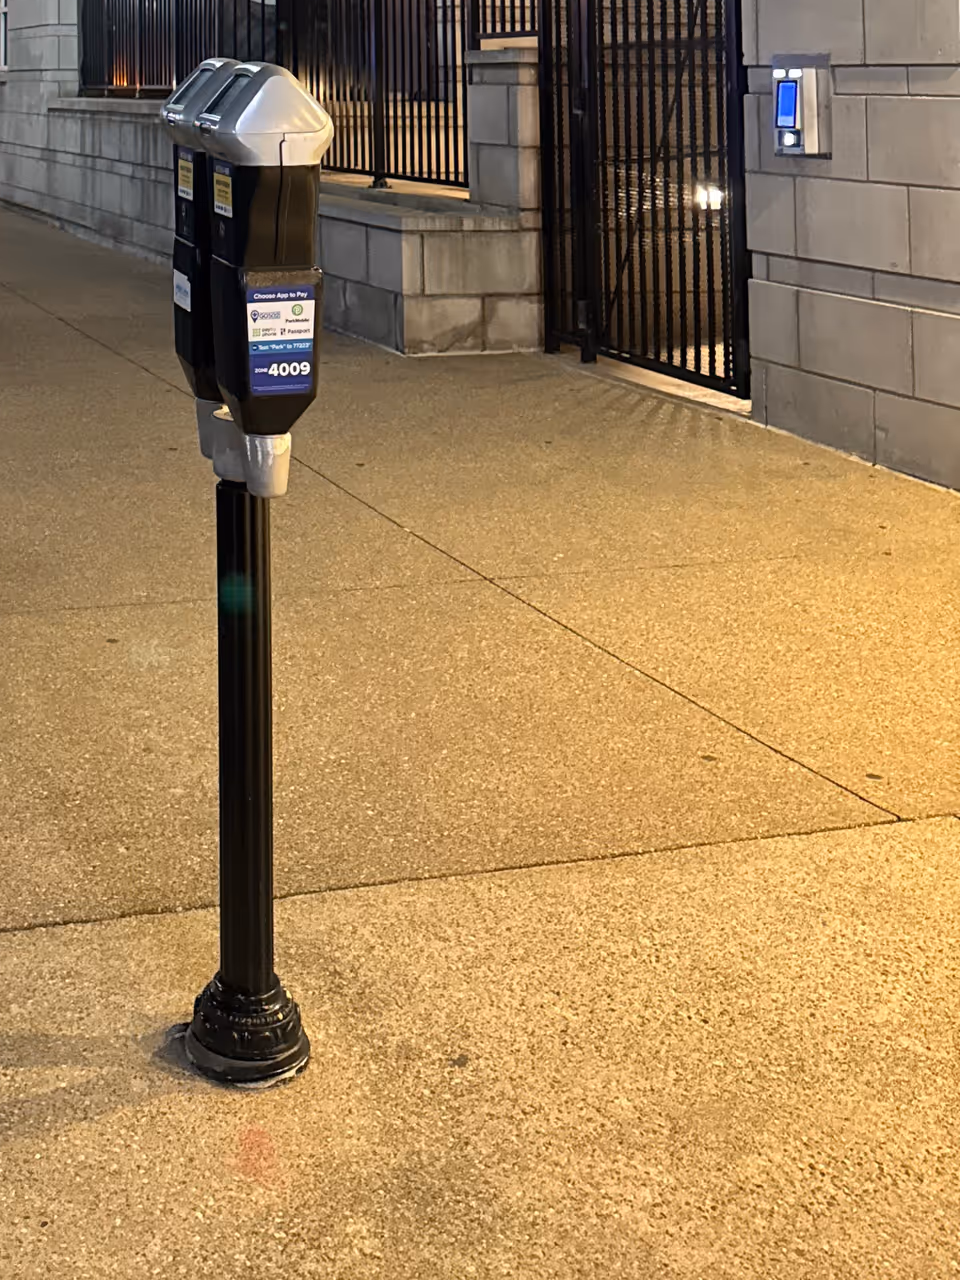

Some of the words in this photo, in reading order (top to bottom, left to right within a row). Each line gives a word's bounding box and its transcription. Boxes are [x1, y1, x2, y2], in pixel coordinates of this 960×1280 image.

[276, 292, 289, 300] App
[296, 291, 308, 299] Pay
[268, 361, 311, 377] 4009
